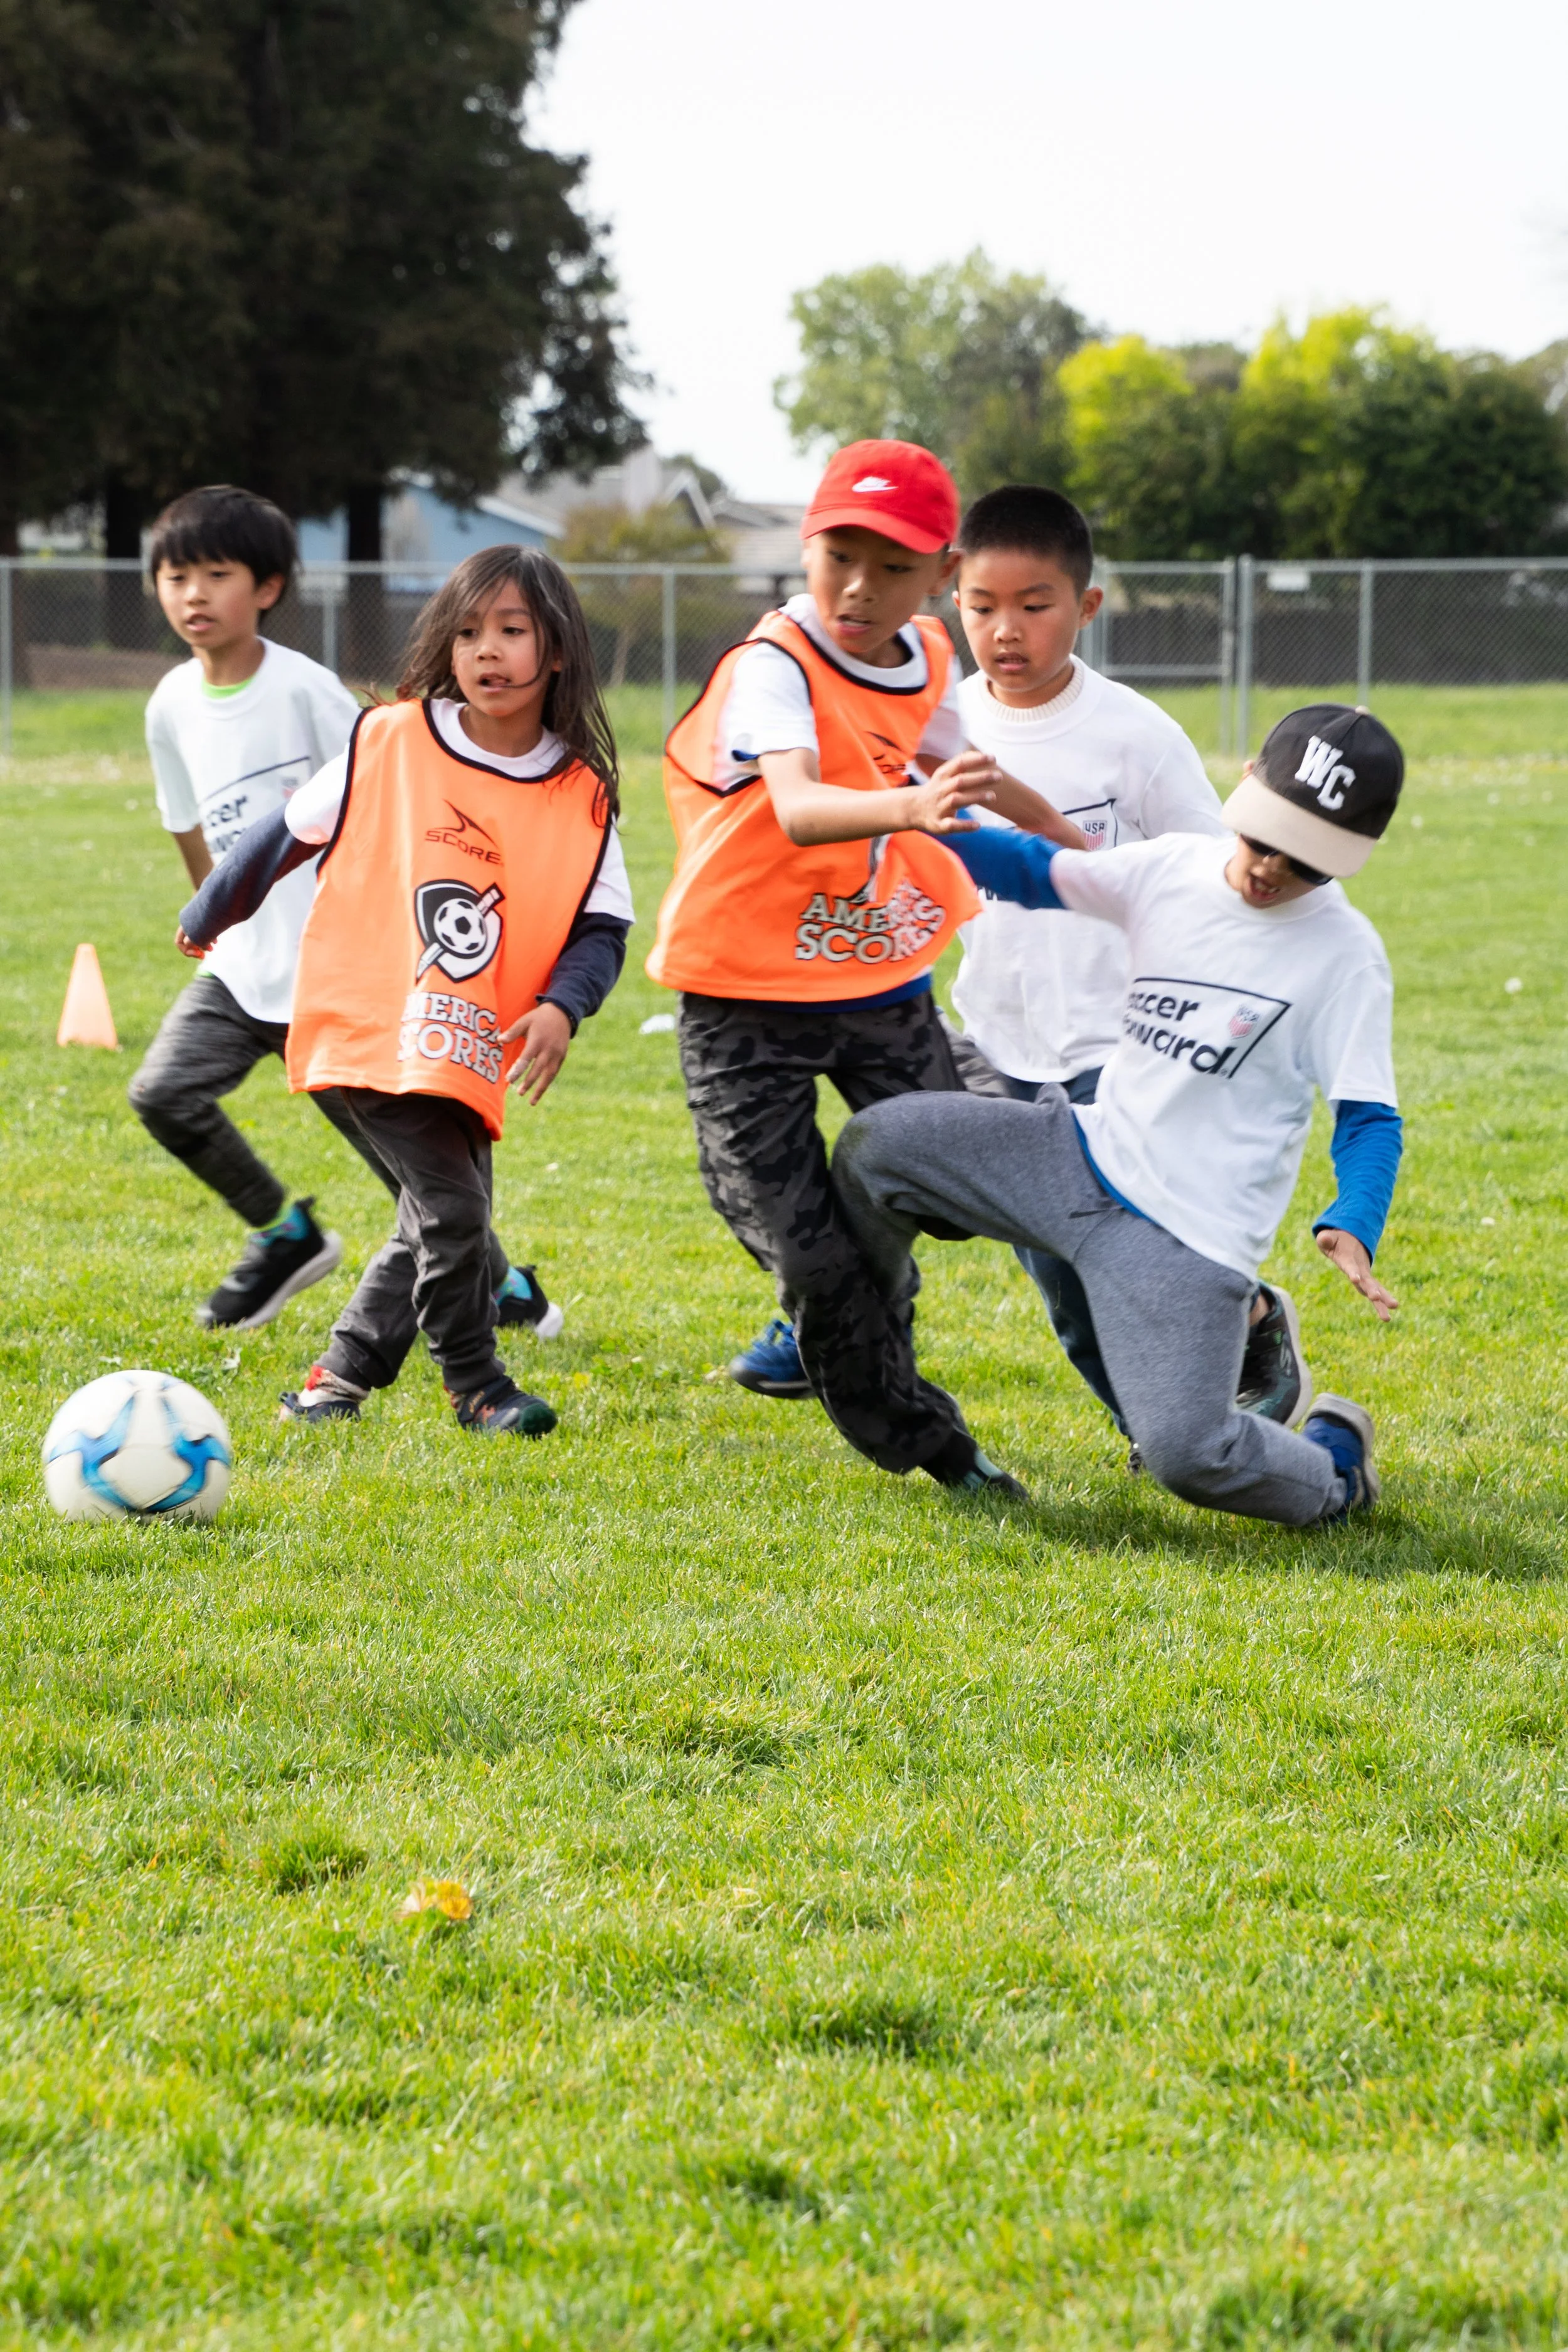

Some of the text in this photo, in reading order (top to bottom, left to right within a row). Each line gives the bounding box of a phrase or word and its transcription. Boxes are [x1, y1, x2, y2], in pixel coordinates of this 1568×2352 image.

[1295, 735, 1357, 811] WC
[1085, 822, 1105, 834] USA
[425, 830, 502, 865] SCORE
